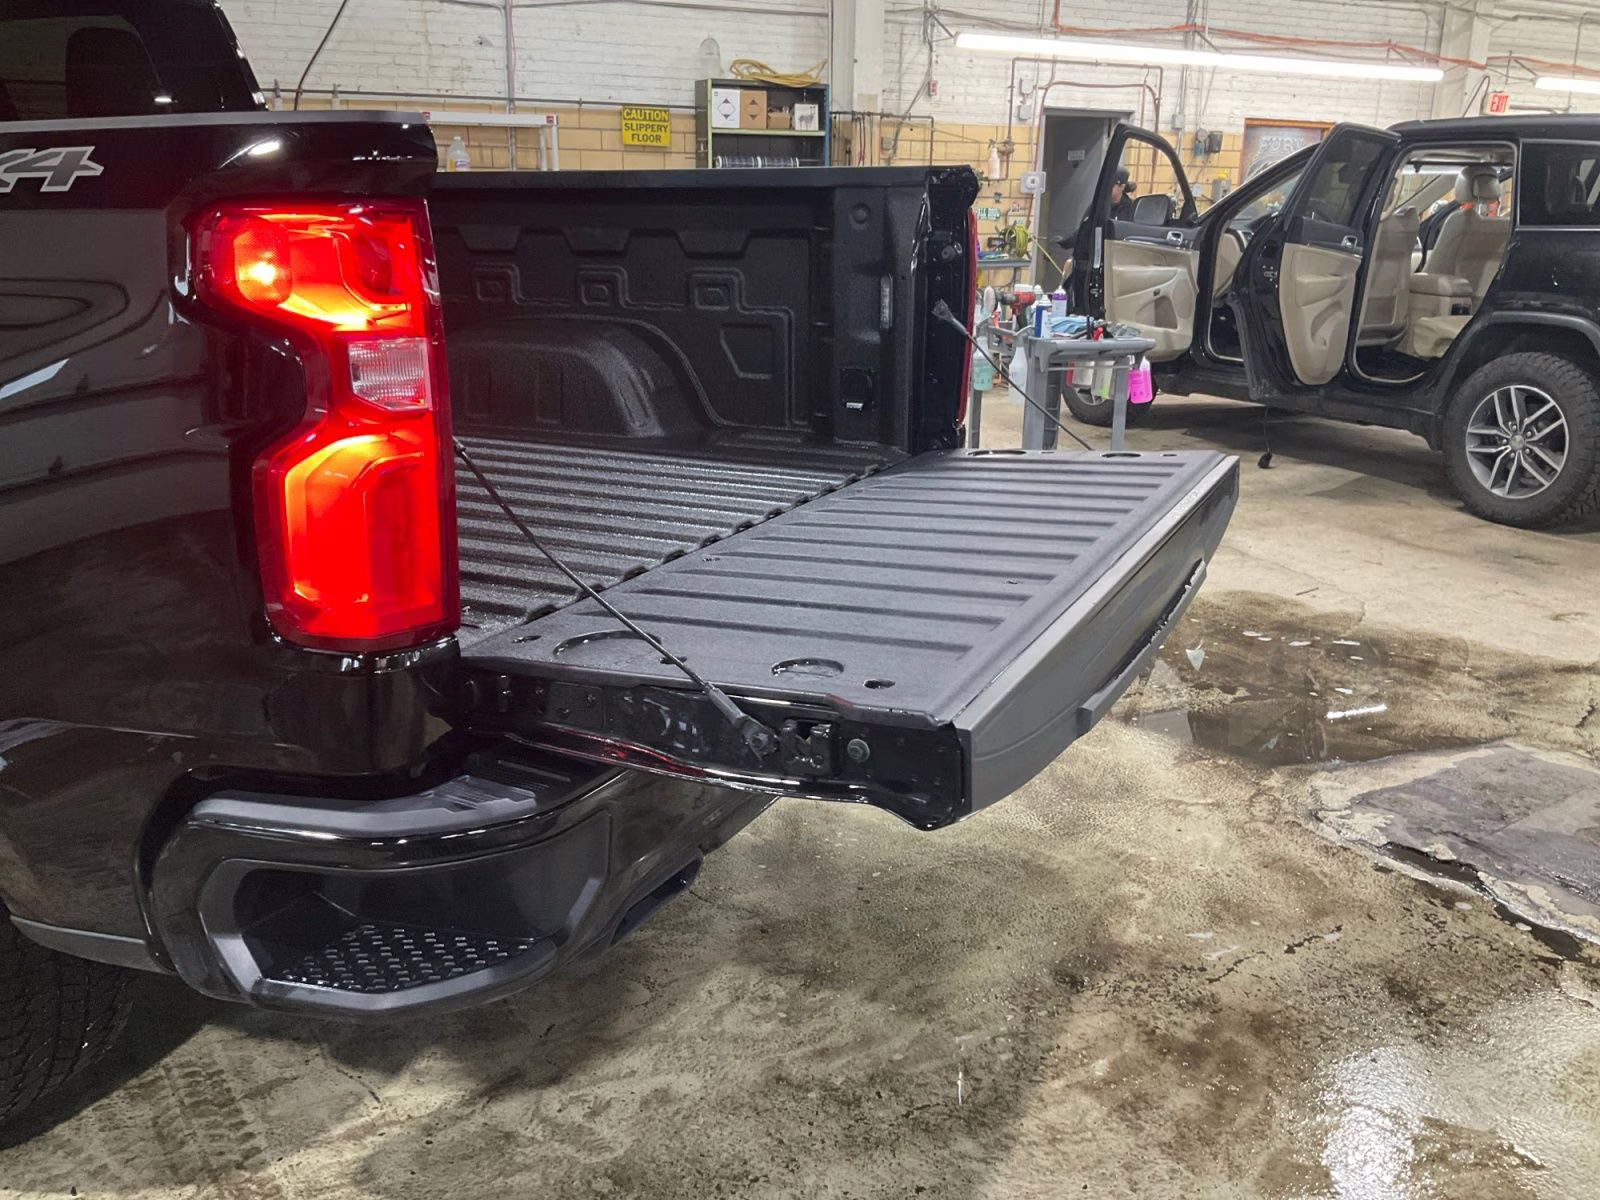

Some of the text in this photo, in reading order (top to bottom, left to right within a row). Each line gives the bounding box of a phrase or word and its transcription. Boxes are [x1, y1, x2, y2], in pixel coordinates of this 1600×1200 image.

[1490, 94, 1509, 113] EXIT
[623, 108, 669, 121] CAUTION
[624, 122, 669, 133] SLIPPERY
[631, 133, 662, 143] FLOOR
